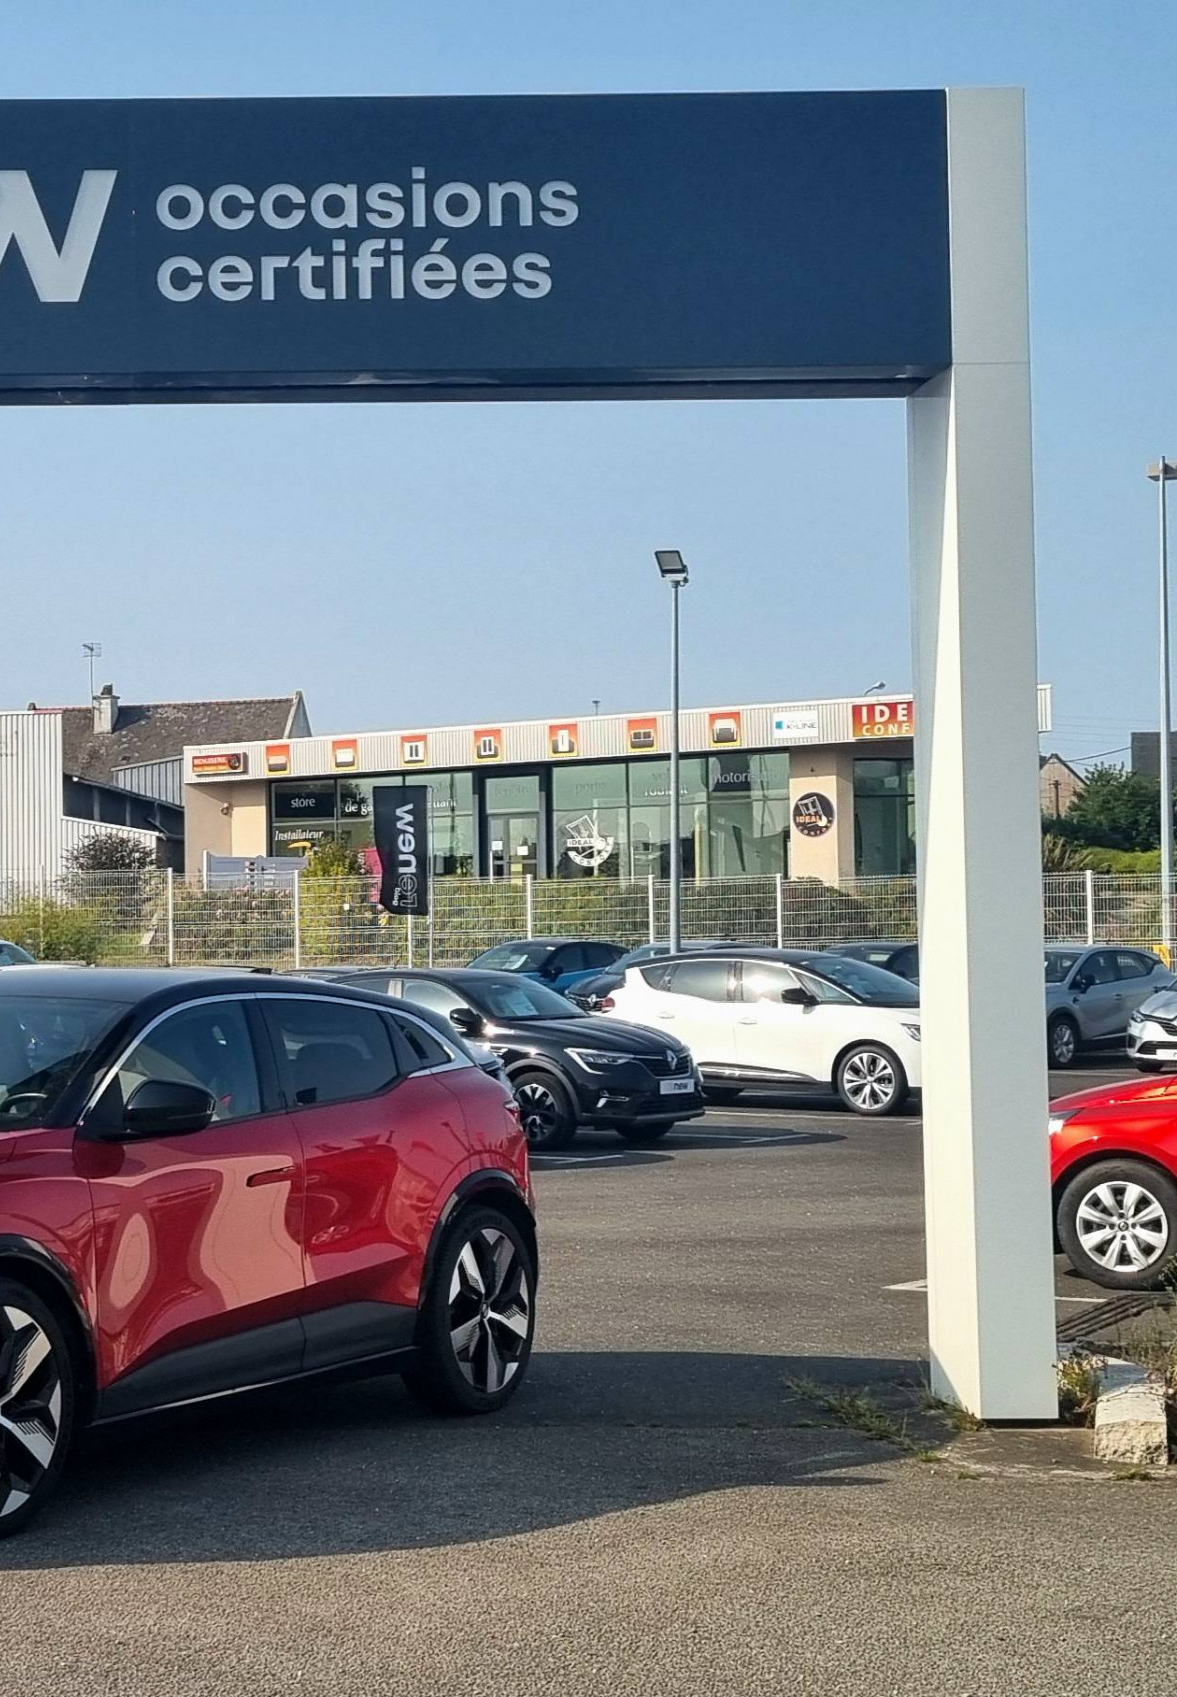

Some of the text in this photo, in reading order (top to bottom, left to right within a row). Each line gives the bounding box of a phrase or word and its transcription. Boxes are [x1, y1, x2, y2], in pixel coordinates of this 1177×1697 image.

[156, 166, 580, 231] occasions
[156, 234, 553, 303] certifiées
[290, 797, 316, 808] store
[274, 829, 324, 841] Installateur
